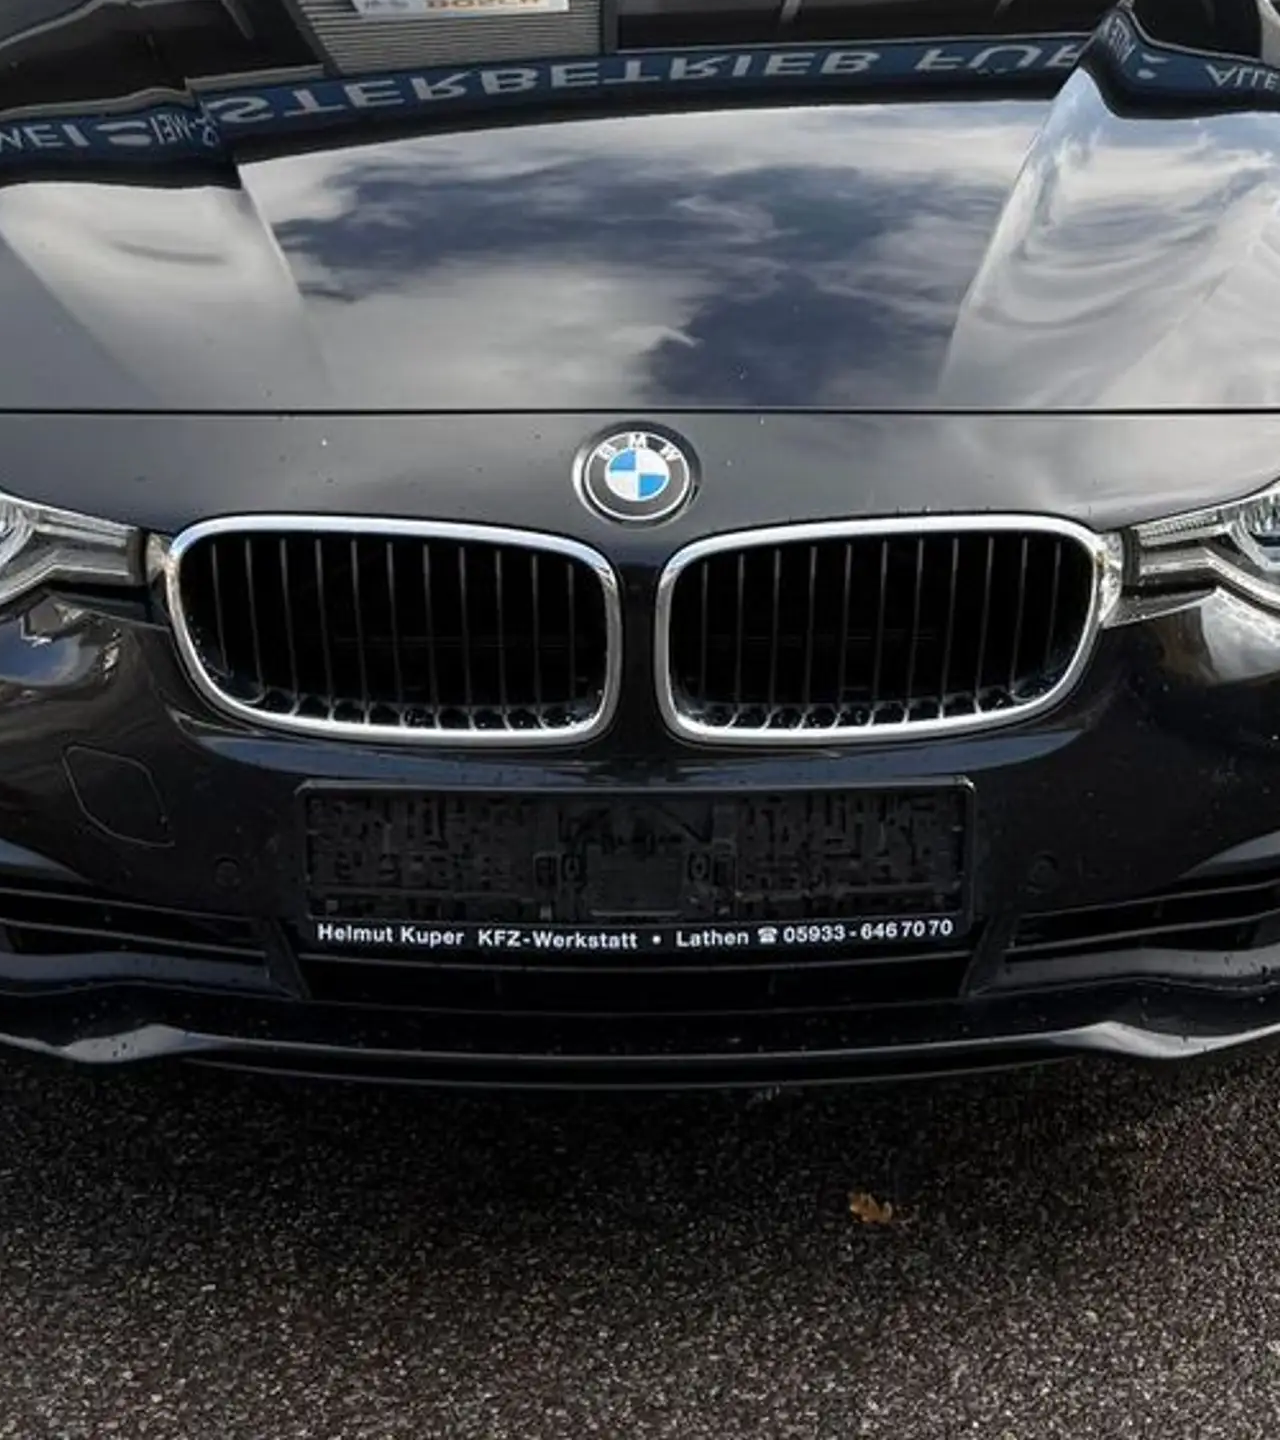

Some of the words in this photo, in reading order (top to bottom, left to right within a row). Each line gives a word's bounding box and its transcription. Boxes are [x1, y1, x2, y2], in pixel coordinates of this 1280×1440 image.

[596, 431, 682, 461] BMW
[317, 923, 393, 944] Helmut
[400, 926, 465, 948] Kuper
[477, 928, 638, 950] KFZ-Werkstatt
[675, 928, 750, 947] Lathen
